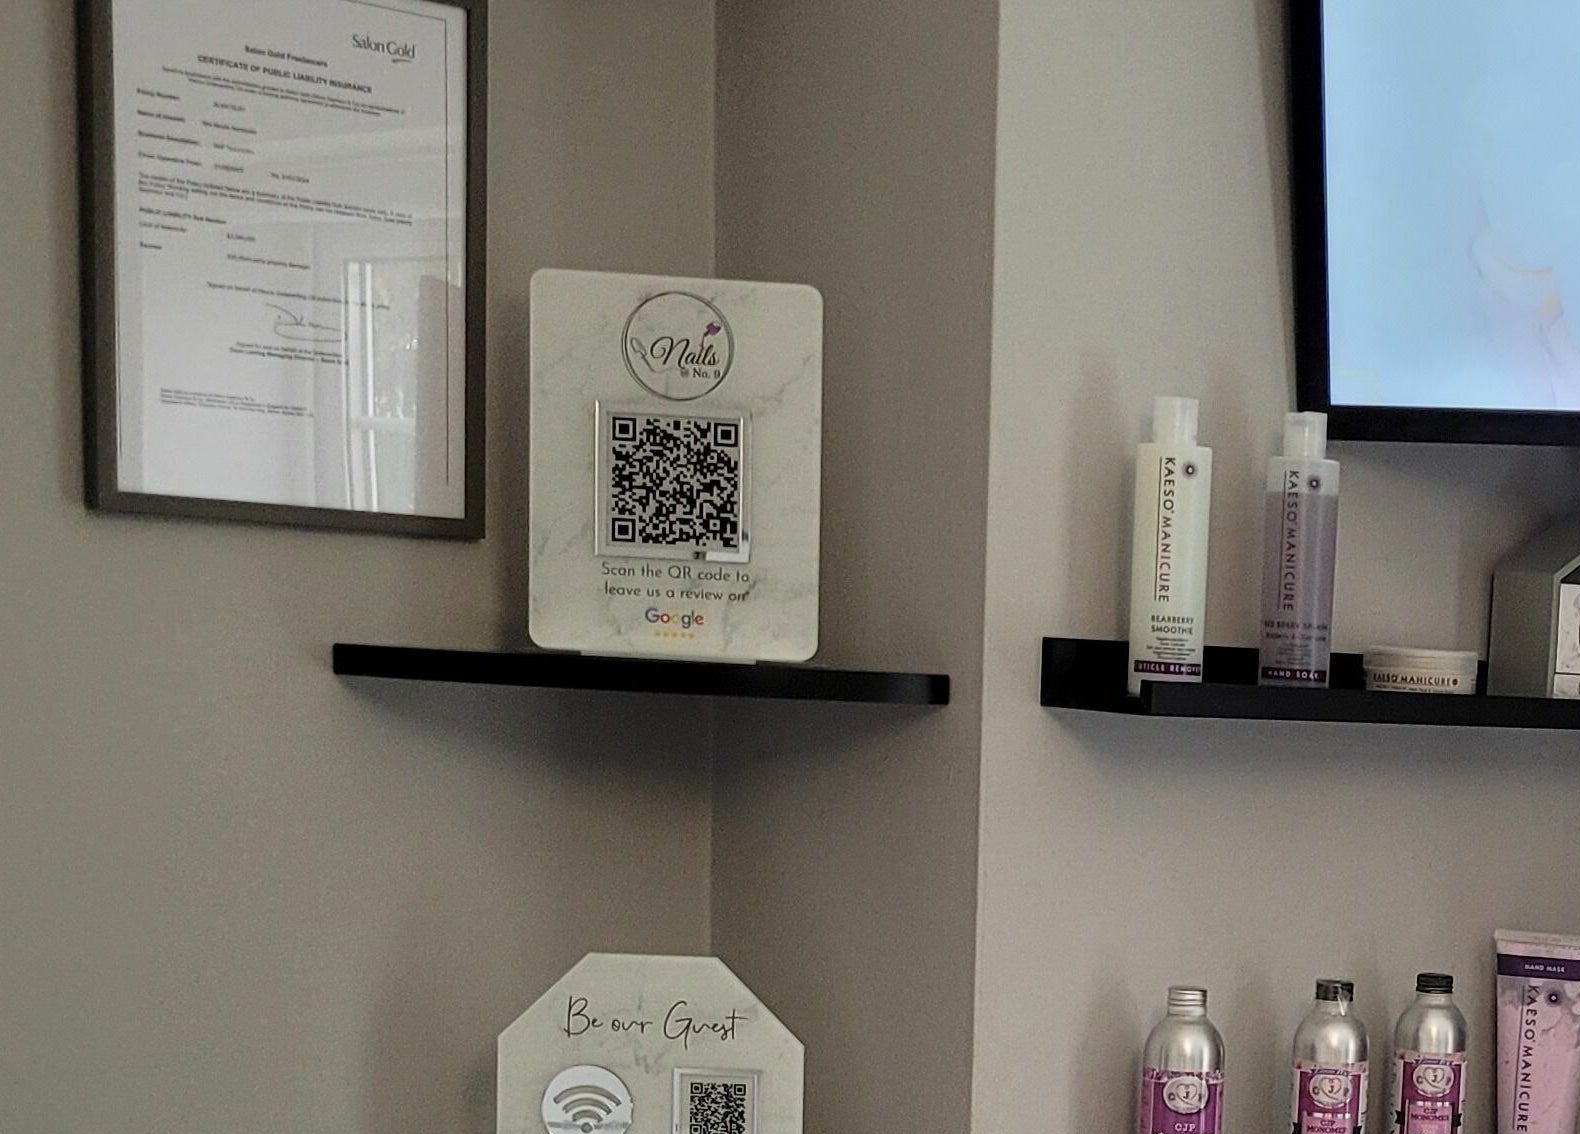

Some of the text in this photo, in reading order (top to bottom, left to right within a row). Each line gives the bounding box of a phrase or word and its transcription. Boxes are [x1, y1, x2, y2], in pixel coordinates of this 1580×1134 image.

[352, 33, 415, 59] Salon Gold
[197, 54, 373, 94] CERTIFICATE OF PUBLIC LIABILITY INSURANCE
[651, 336, 719, 369] Nails
[692, 368, 711, 379] No.
[713, 368, 721, 379] 9
[1157, 515, 1172, 603] MANICURE
[1282, 526, 1296, 612] MANICURE
[602, 562, 749, 583] Scan the QR code to
[604, 582, 747, 602] leave us a review on
[645, 607, 704, 628] Google
[1151, 615, 1194, 624] BEARBERRY
[1151, 625, 1193, 635] SMOOTHIE
[1401, 675, 1451, 687] MANICURE
[1524, 963, 1566, 973] HAND MASK
[563, 996, 748, 1050] Be our Guest
[1517, 1045, 1534, 1133] MANICURE
[1174, 1122, 1195, 1132] CJP
